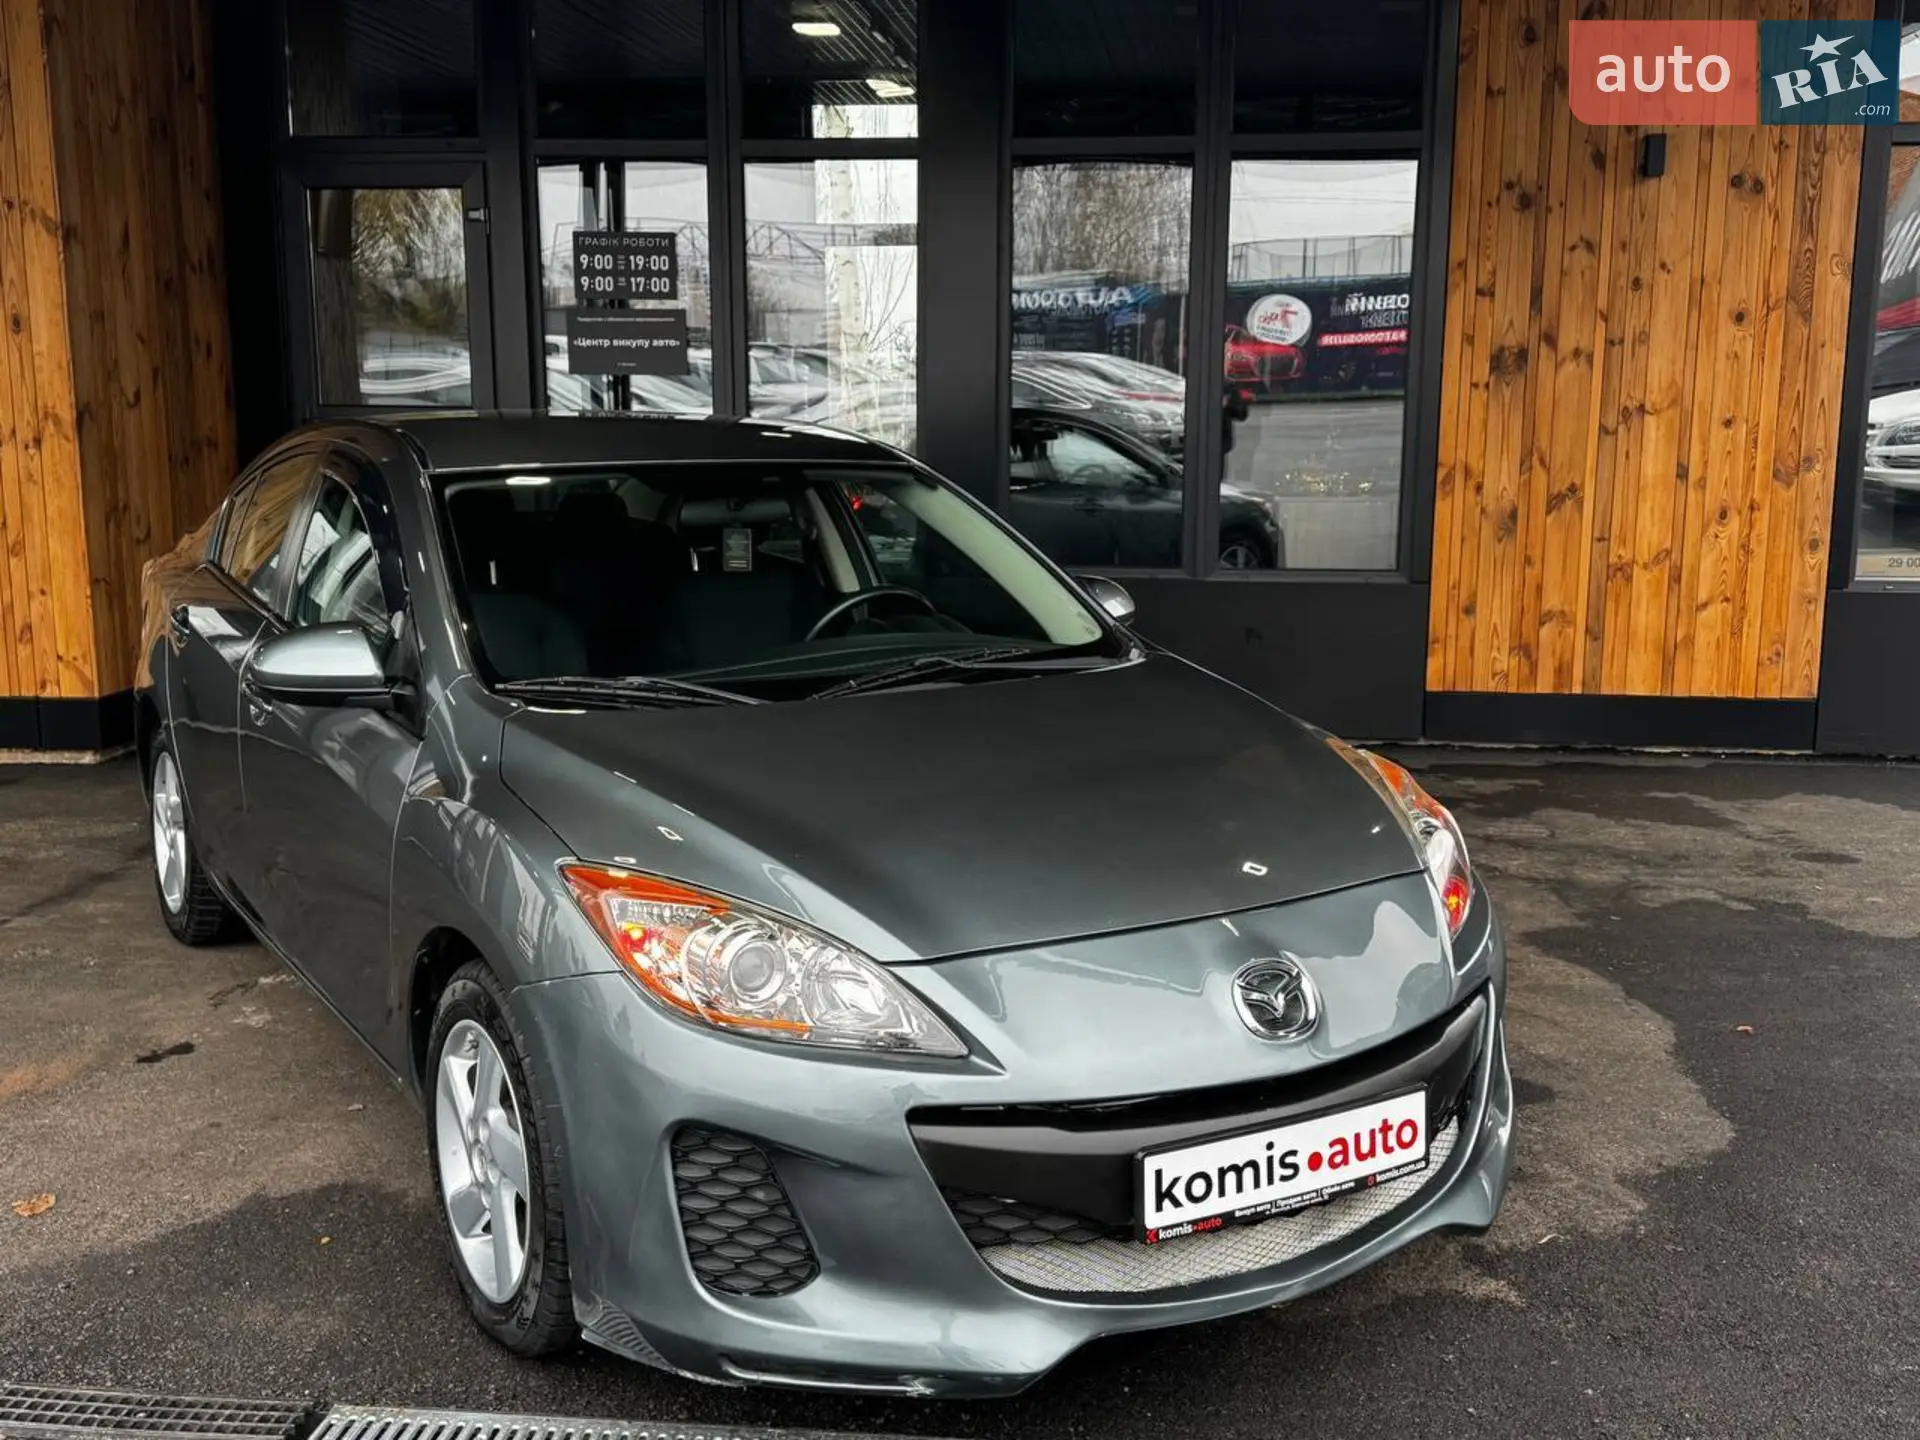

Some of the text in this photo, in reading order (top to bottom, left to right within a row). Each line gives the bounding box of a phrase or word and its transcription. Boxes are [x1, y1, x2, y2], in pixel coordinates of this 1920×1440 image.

[578, 236, 669, 248] ГРАФІК РОБОТИ
[580, 254, 613, 270] 9:00
[629, 255, 669, 271] 19:00
[581, 276, 614, 291] 9:00
[630, 277, 670, 292] 17:00
[573, 337, 680, 348] «Центр викупу авто»
